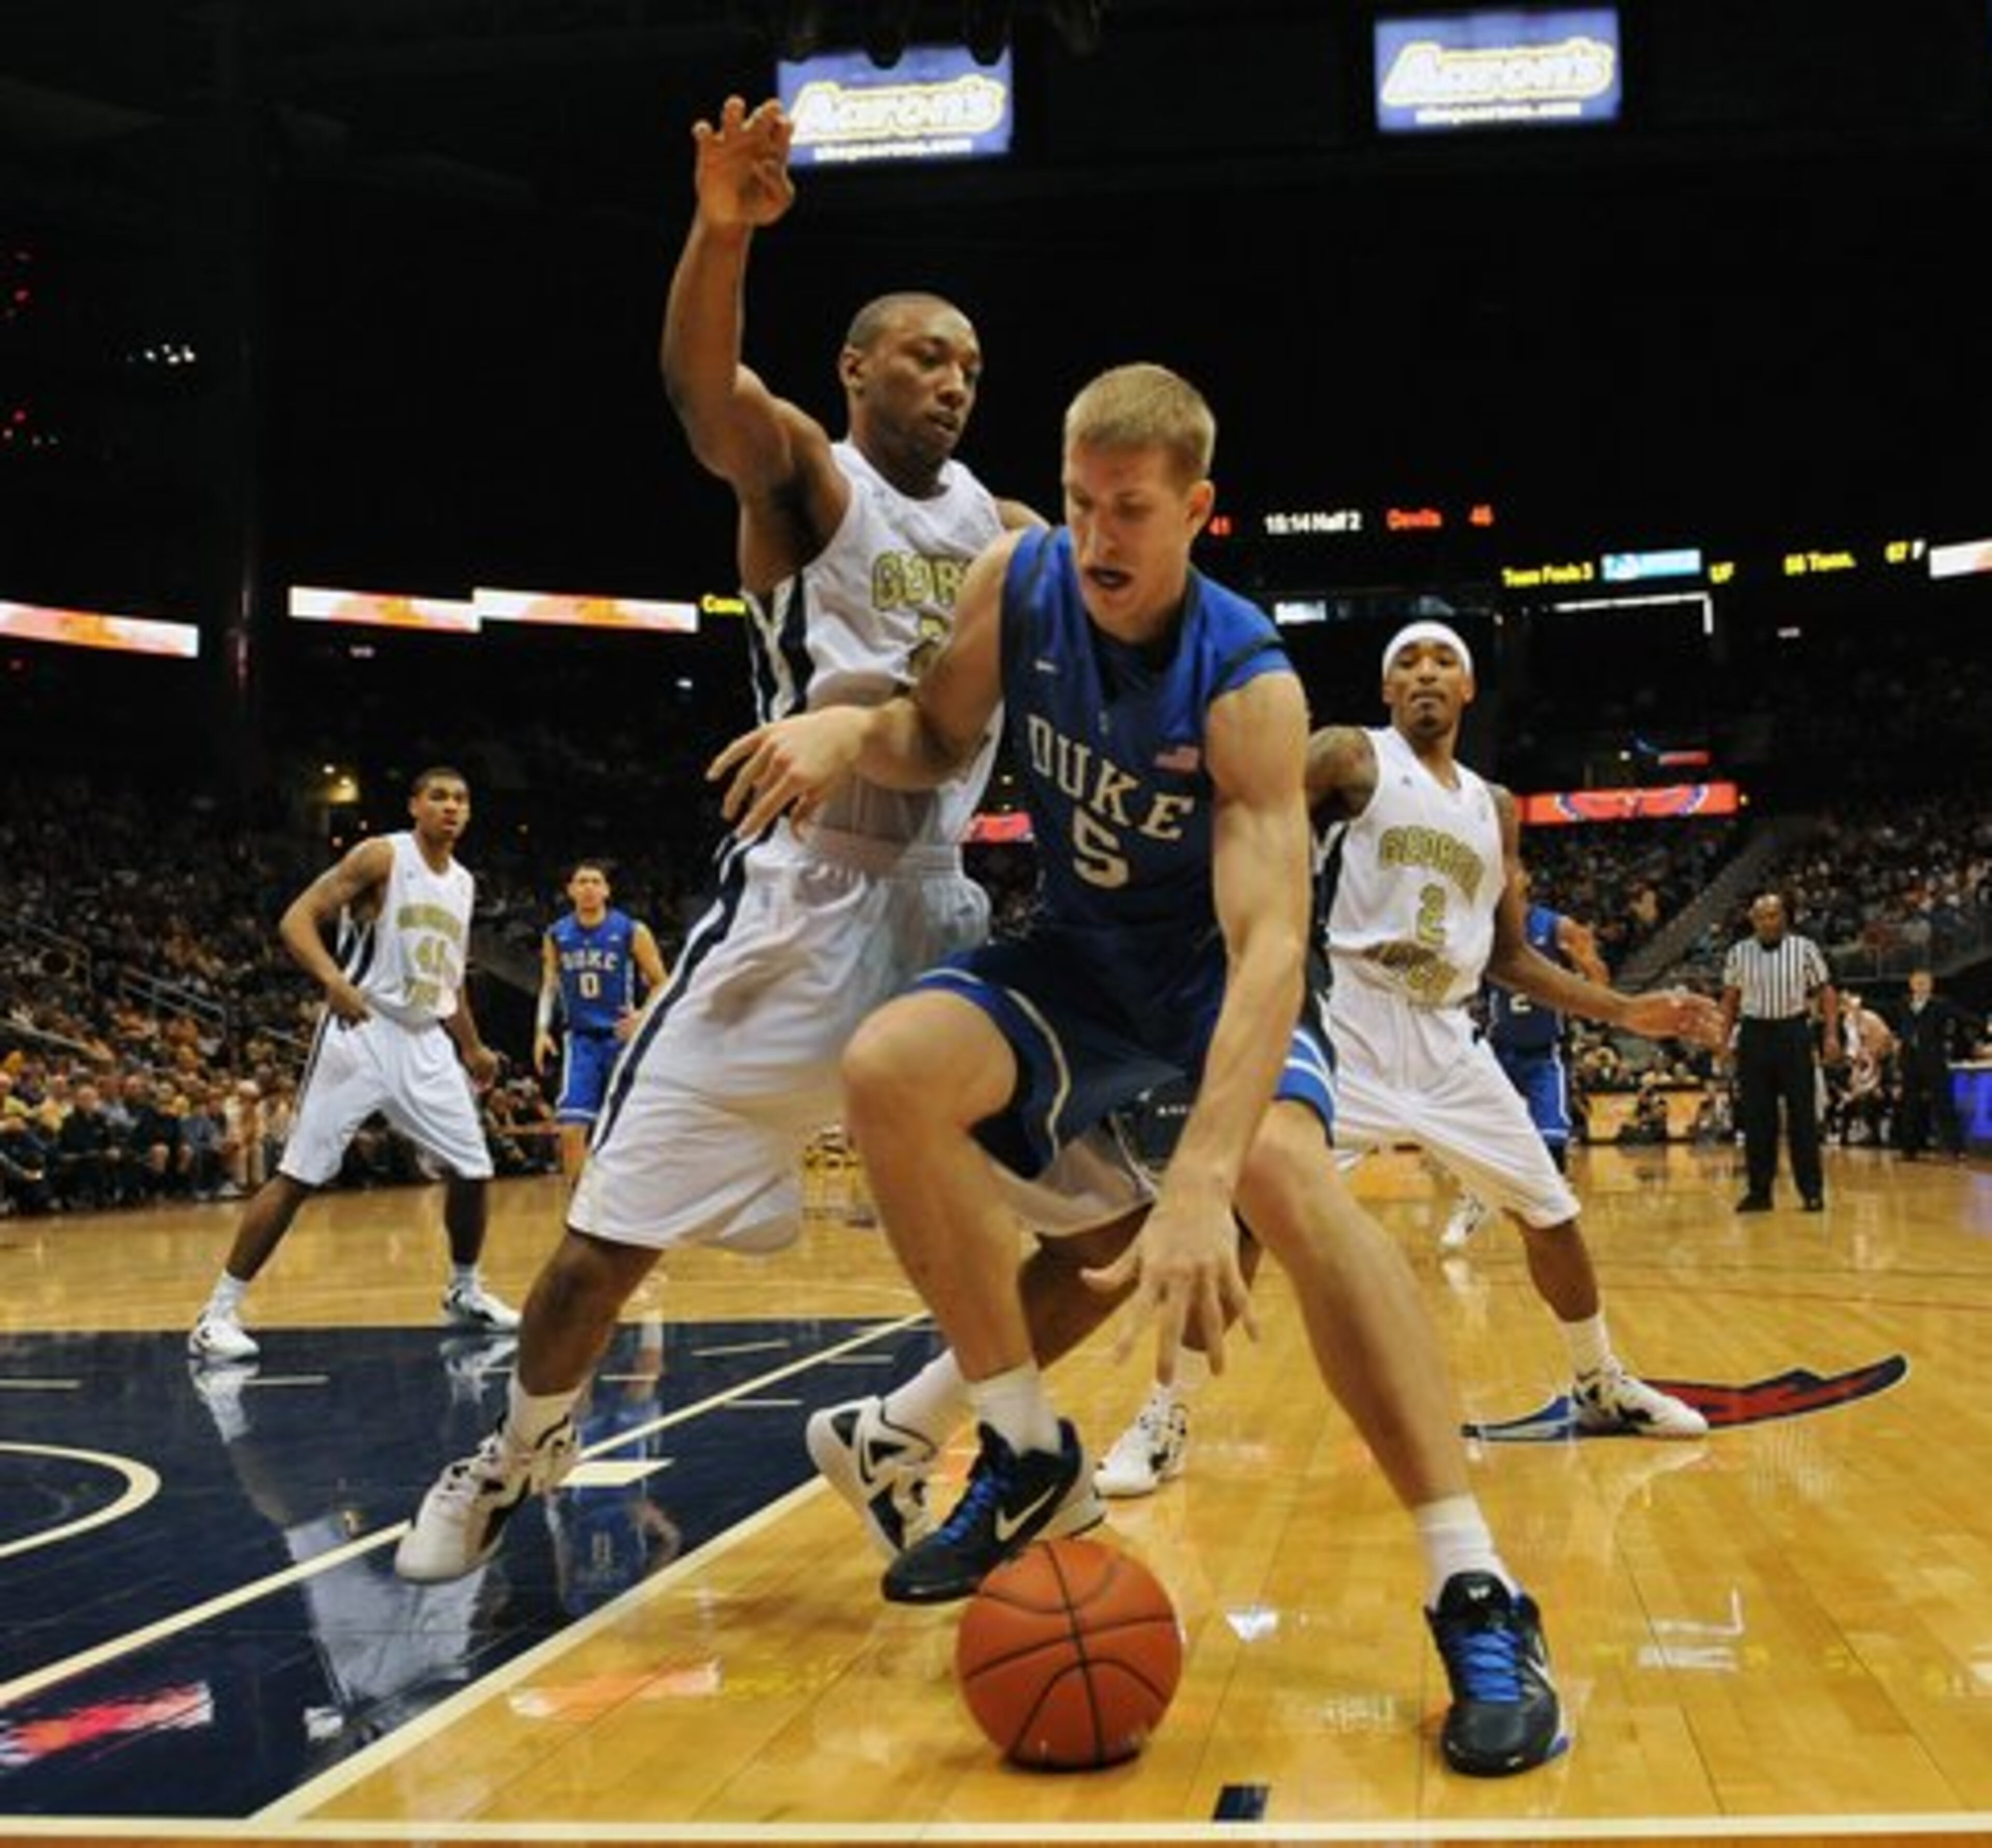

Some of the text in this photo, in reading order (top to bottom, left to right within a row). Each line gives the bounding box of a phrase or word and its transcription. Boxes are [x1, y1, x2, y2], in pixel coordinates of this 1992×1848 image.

[1028, 714, 1195, 840] DUKE
[1072, 805, 1129, 889] 5
[1417, 883, 1446, 946] 2
[579, 972, 600, 999] 0
